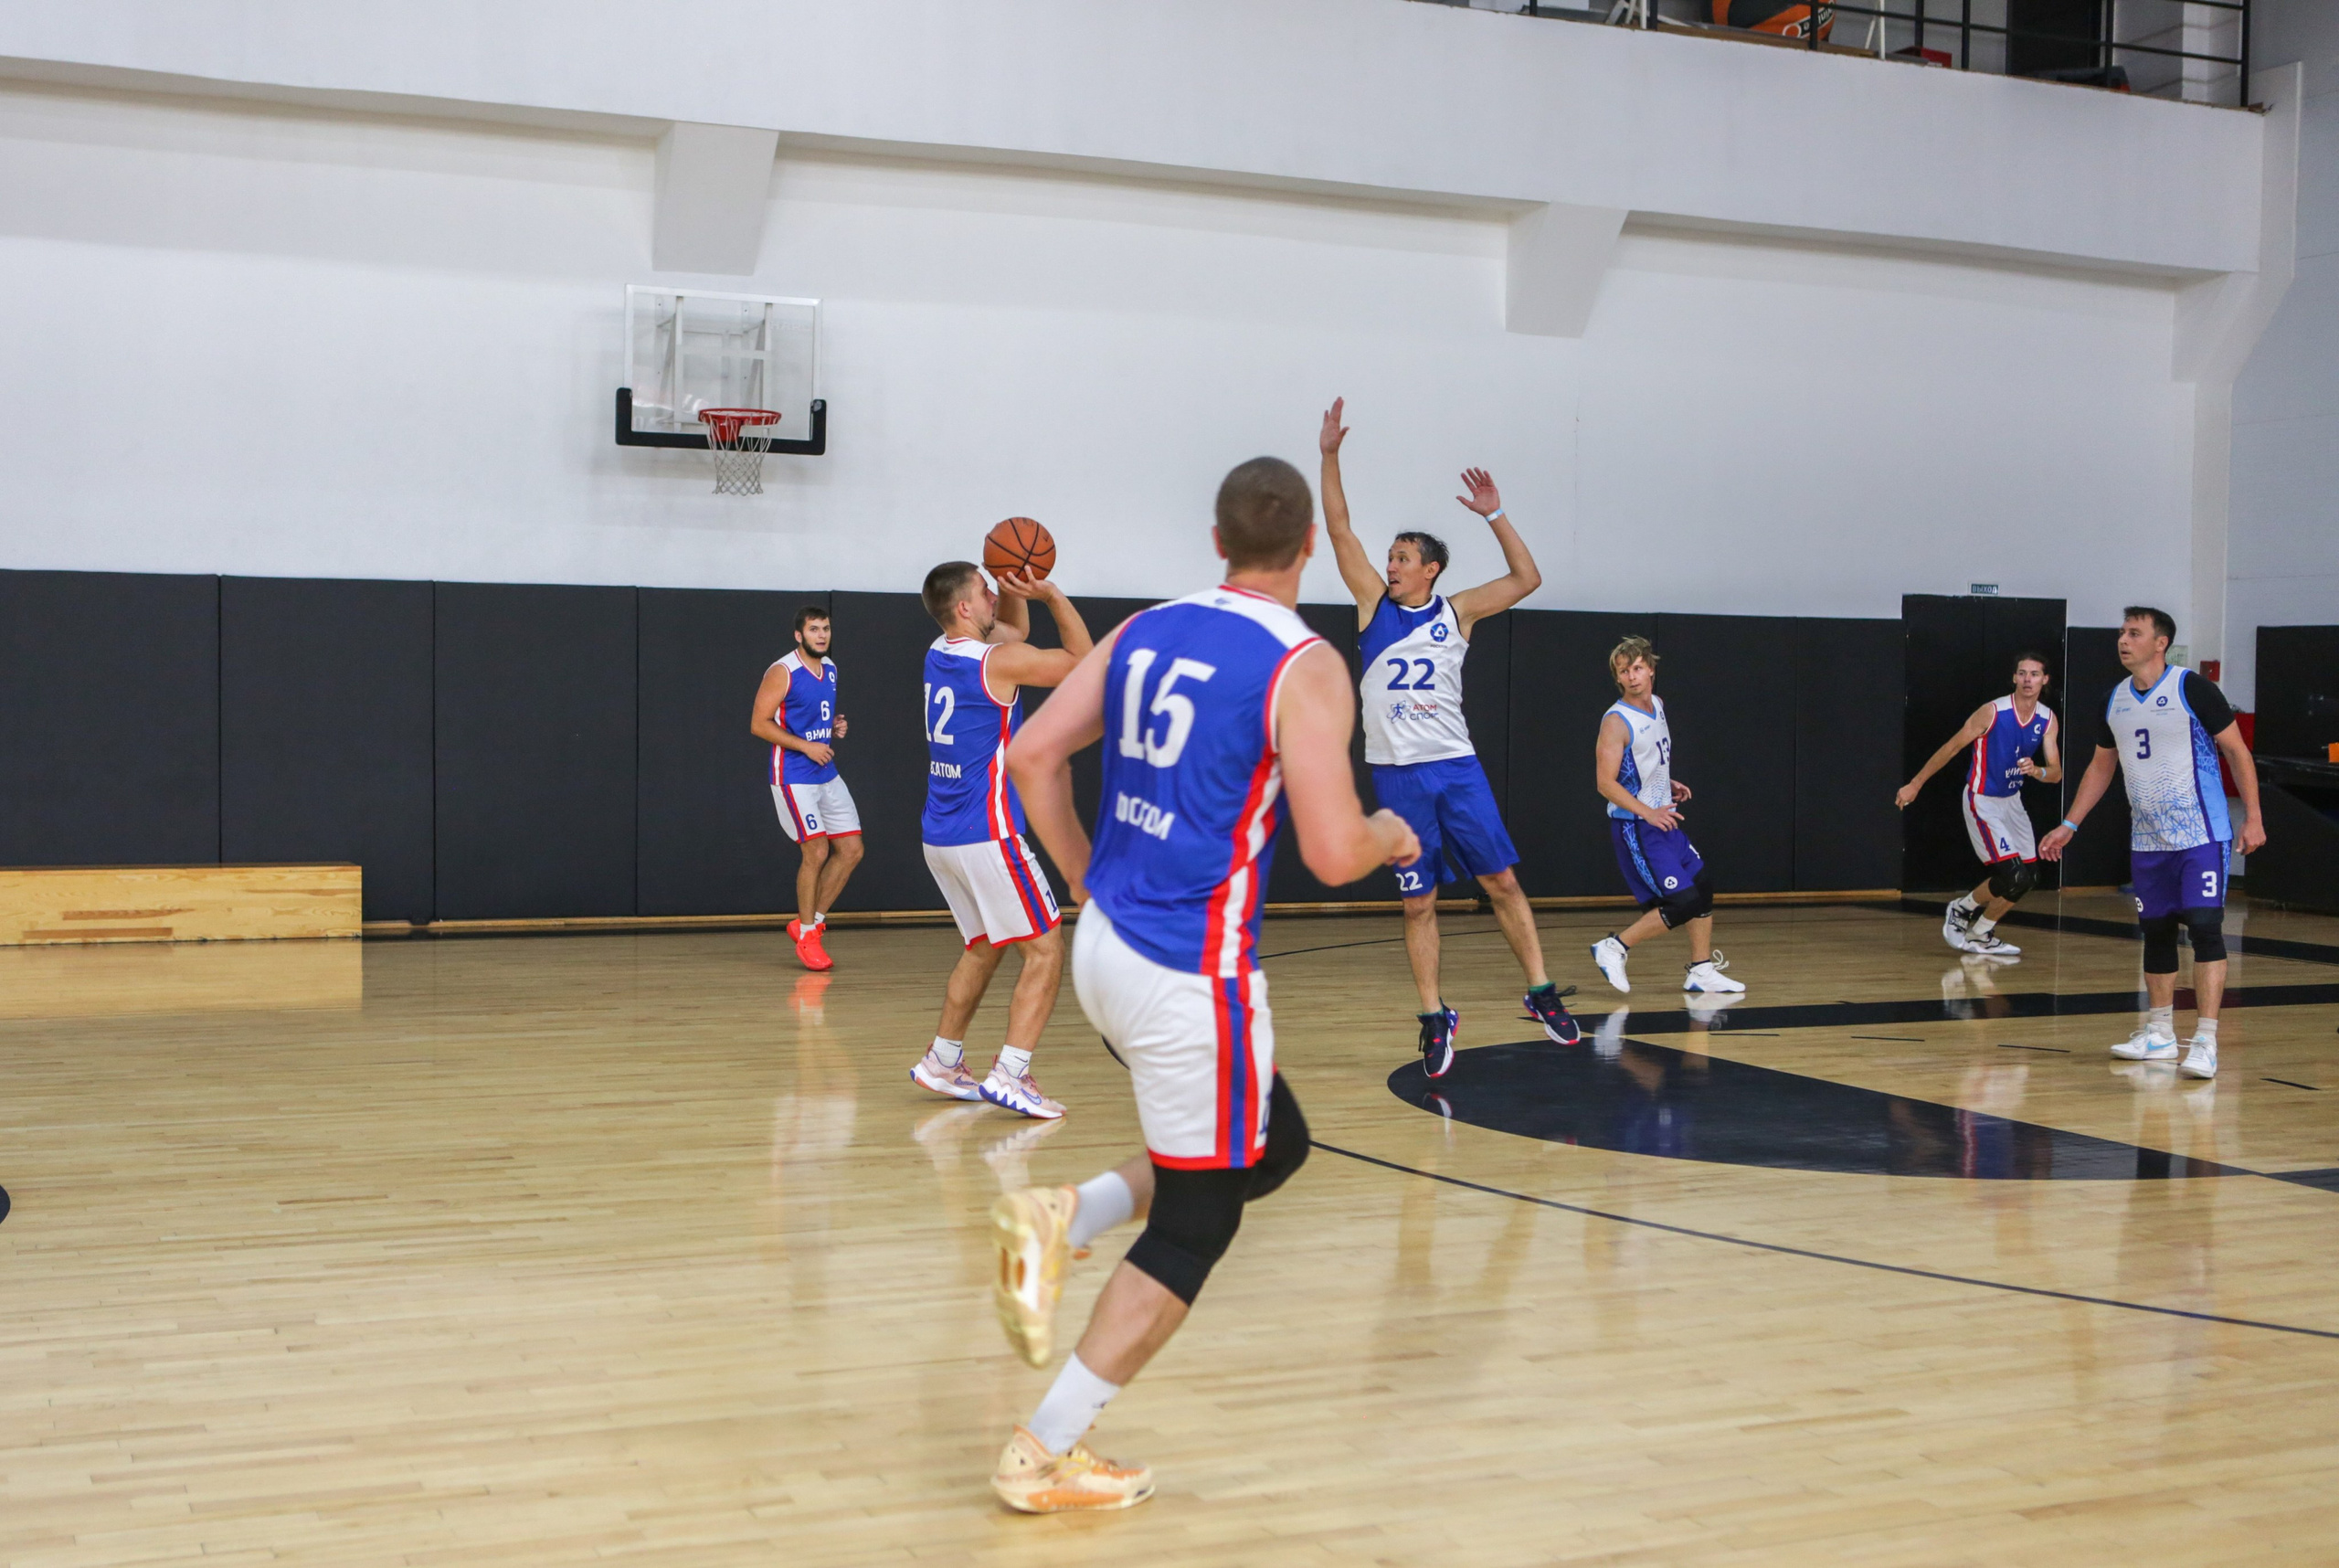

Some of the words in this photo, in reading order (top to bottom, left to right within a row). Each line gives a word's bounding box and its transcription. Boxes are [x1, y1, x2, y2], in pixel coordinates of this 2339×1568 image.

[1387, 658, 1435, 690] 22
[820, 700, 831, 721] 6
[925, 682, 955, 745] 12
[1119, 648, 1217, 768] 15
[1413, 704, 1437, 712] АТОМ
[2134, 728, 2151, 759] 3
[805, 813, 818, 830] 6
[2000, 837, 2011, 852] 4
[1395, 871, 1424, 891] 22
[2202, 871, 2217, 897] 3
